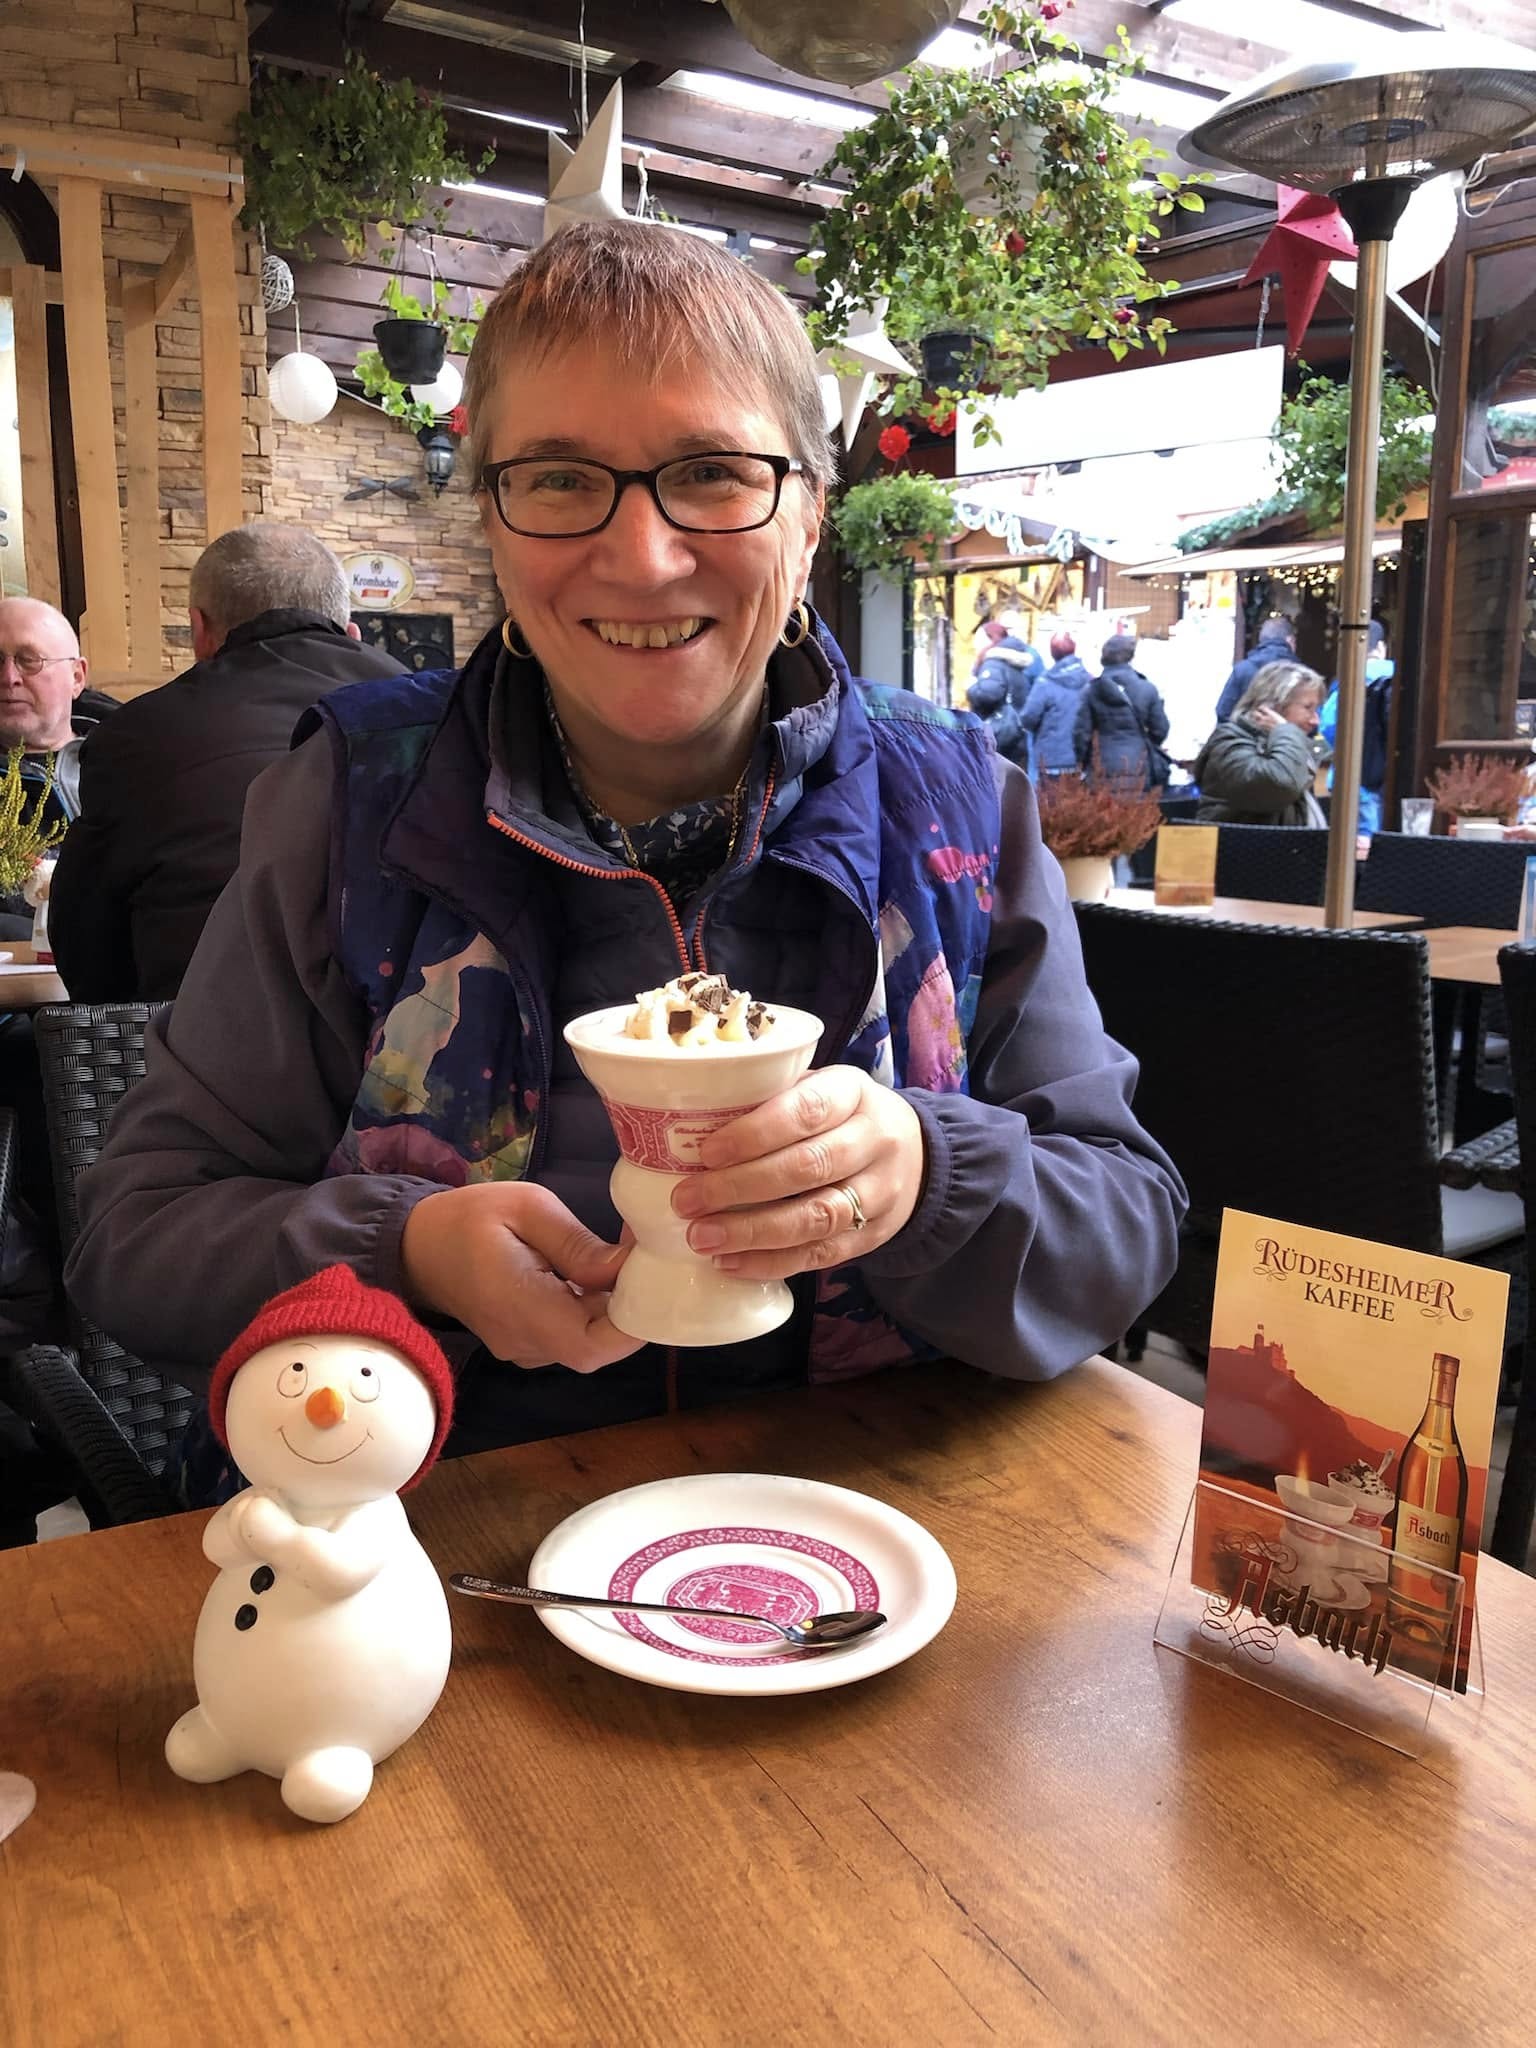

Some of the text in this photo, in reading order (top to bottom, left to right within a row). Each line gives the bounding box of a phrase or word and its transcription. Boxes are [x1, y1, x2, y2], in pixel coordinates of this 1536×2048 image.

[352, 574, 399, 588] Krombacher
[1254, 1238, 1474, 1322] RÜDESHEIMER
[1304, 1281, 1395, 1322] KAFFEE
[1406, 1514, 1450, 1545] Asbach
[1222, 1548, 1393, 1677] Asbach
